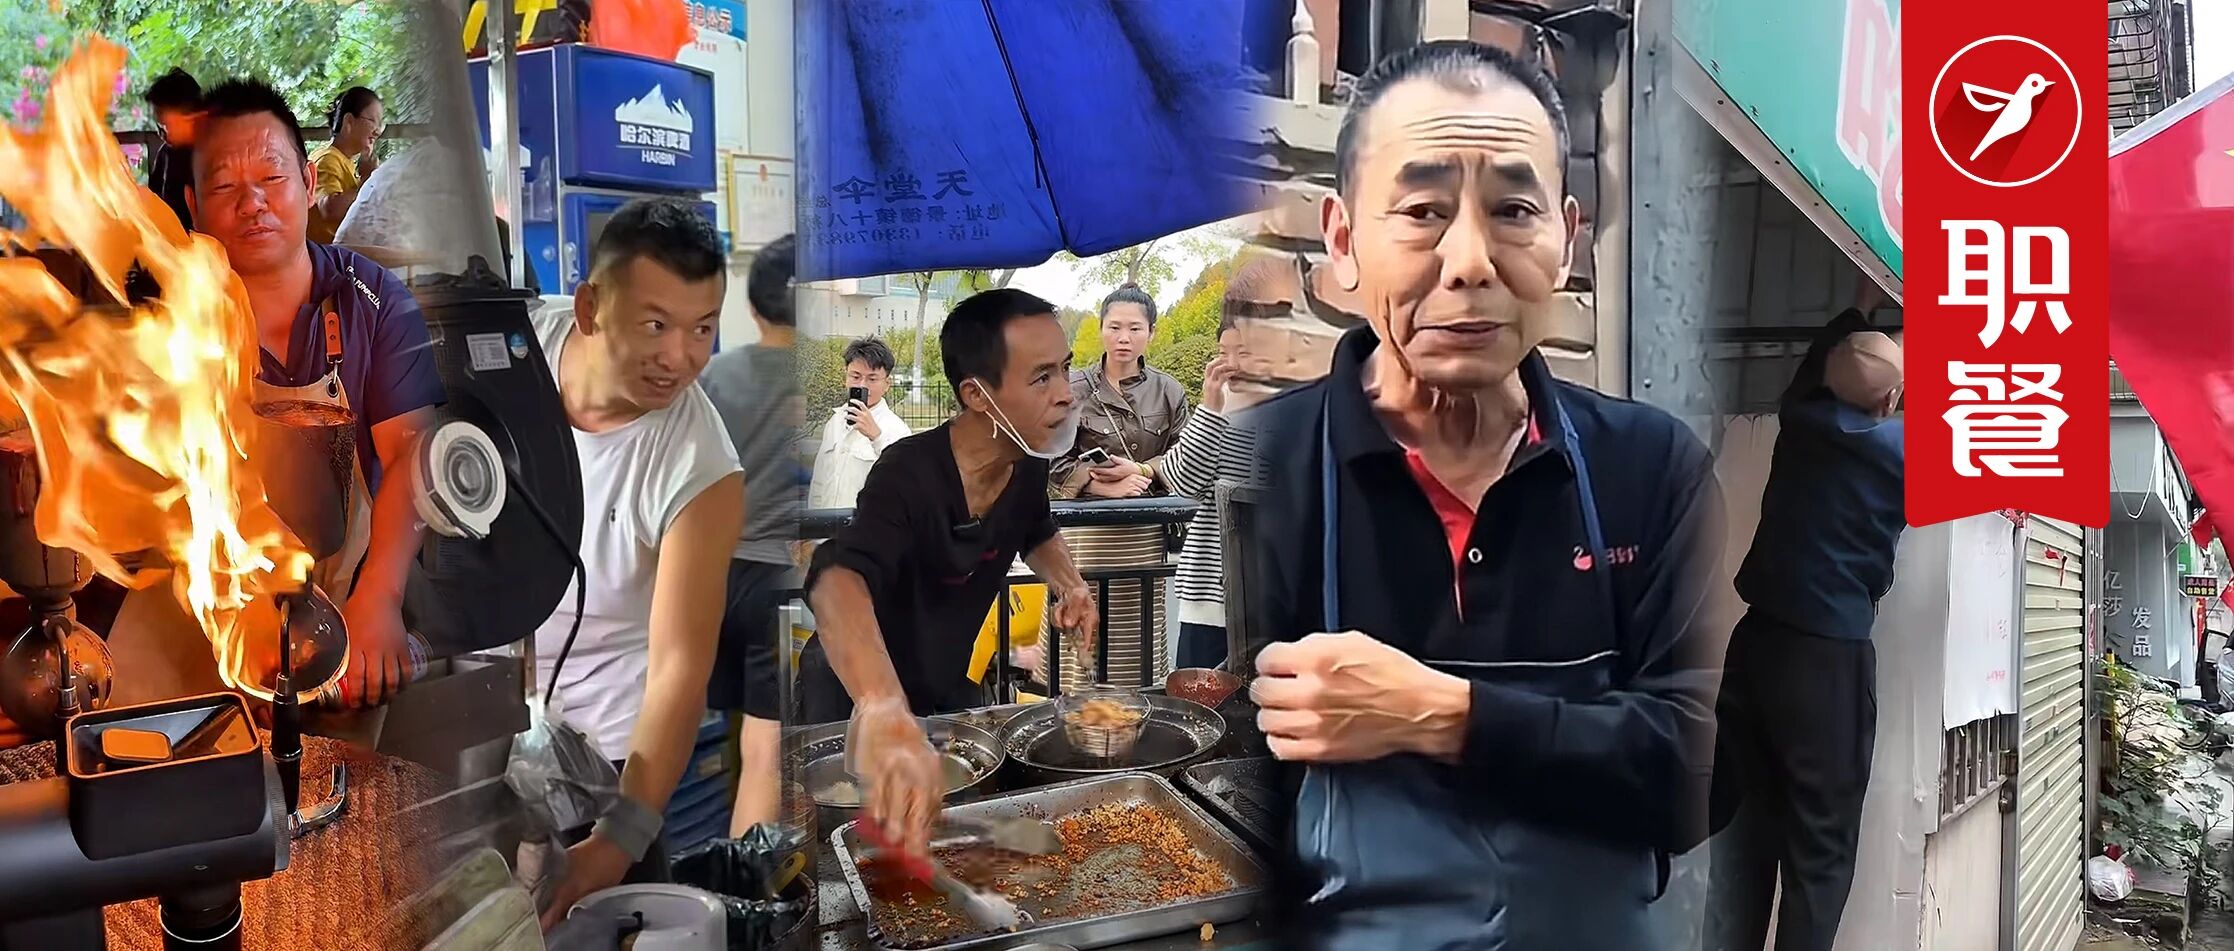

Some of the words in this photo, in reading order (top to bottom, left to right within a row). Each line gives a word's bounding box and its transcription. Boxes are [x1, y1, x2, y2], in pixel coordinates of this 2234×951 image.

[619, 124, 691, 151] 哈尔滨啤酒
[641, 149, 676, 166] HARBIN
[2131, 606, 2152, 656] 发品
